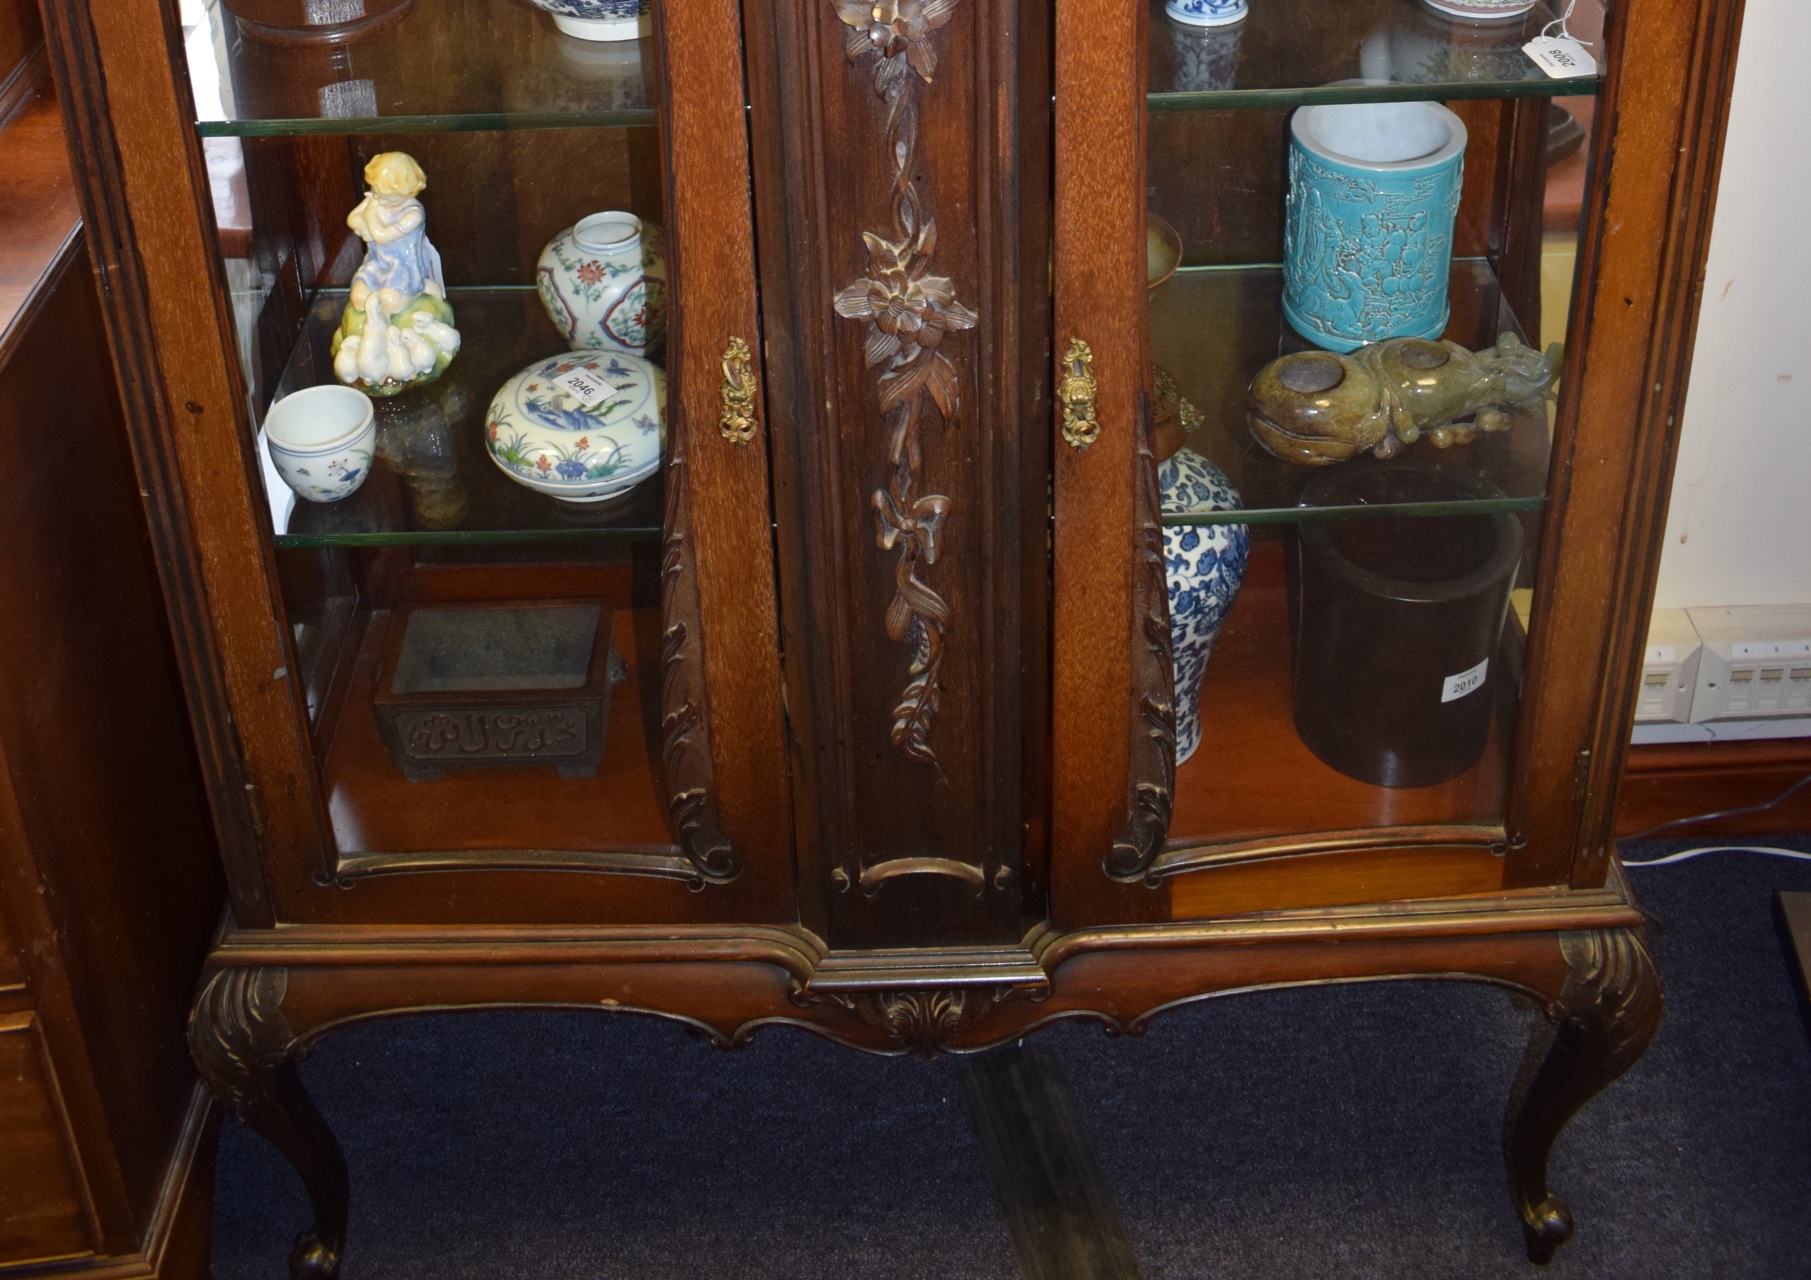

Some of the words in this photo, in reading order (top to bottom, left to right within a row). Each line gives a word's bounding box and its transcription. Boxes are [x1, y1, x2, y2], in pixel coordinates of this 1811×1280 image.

[1549, 49, 1576, 67] 2008
[567, 377, 595, 395] 2046
[1453, 675, 1478, 694] 2010
